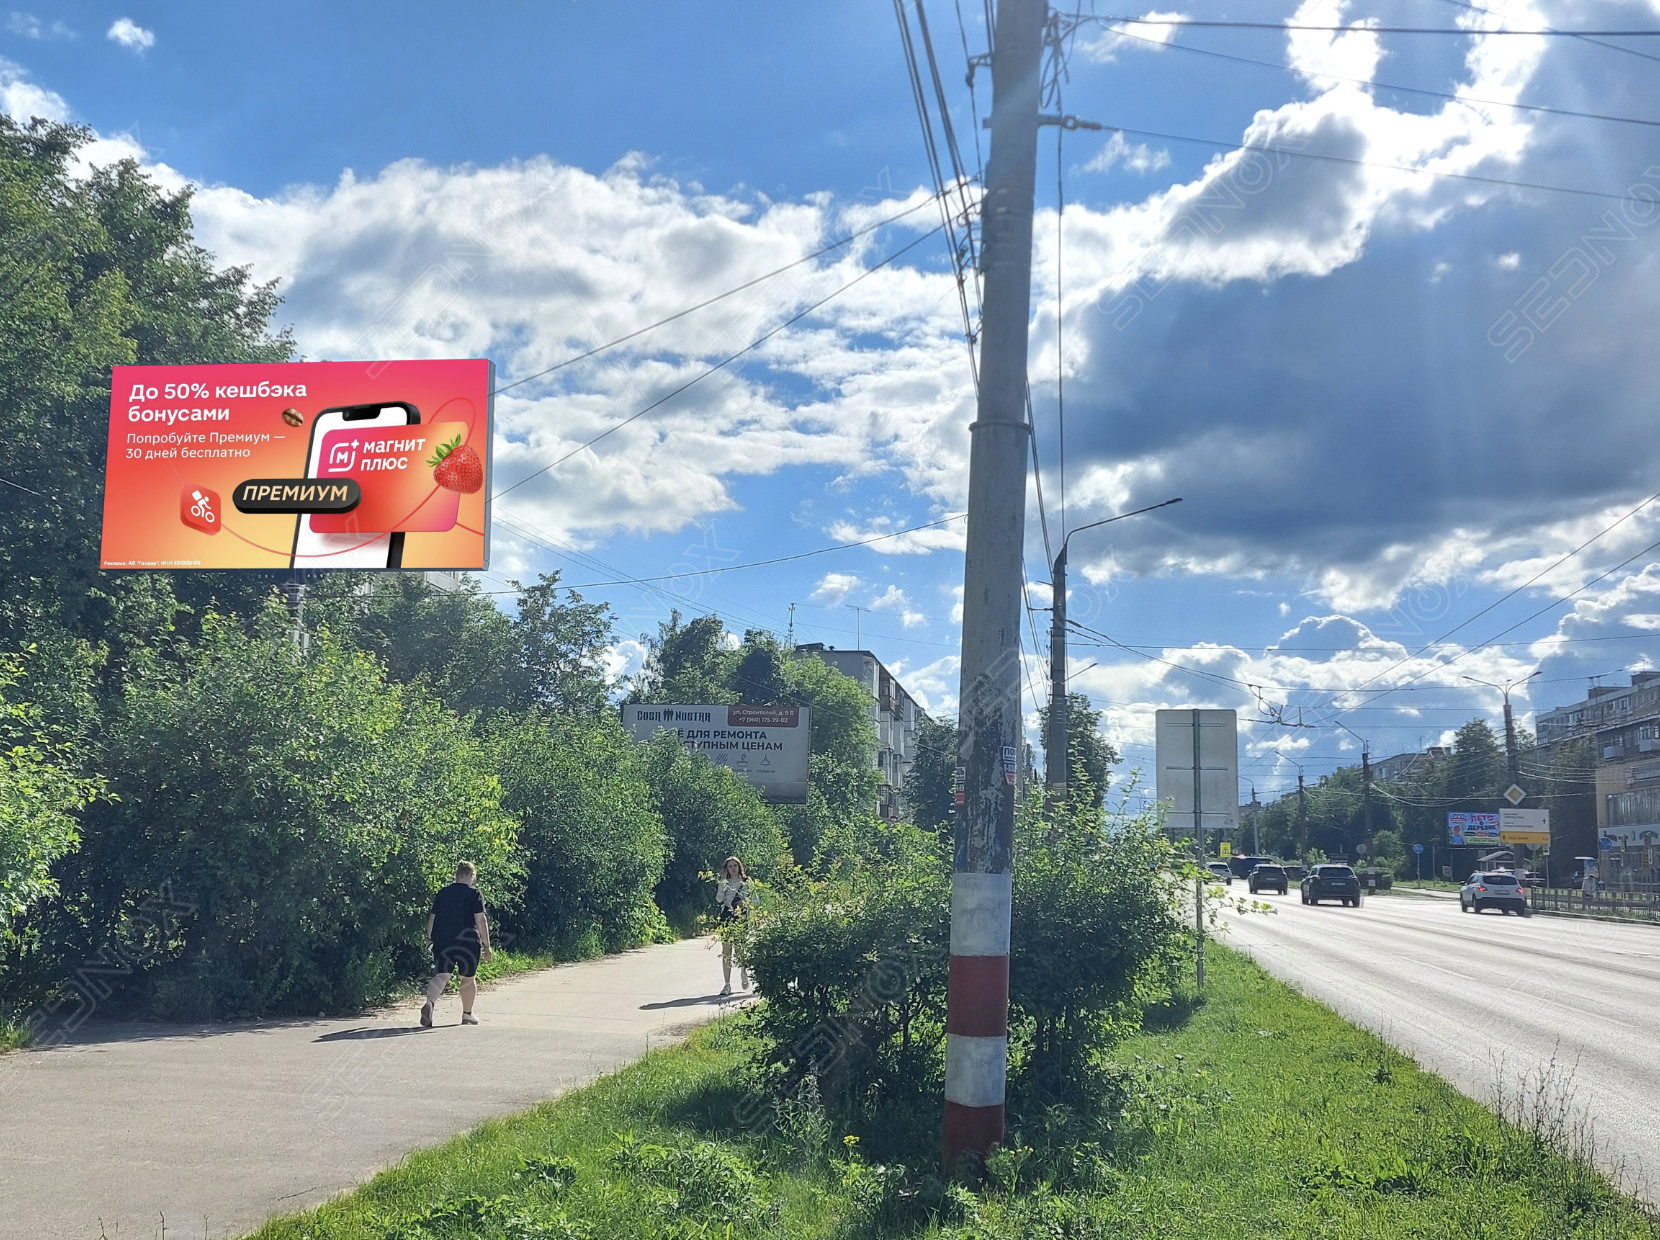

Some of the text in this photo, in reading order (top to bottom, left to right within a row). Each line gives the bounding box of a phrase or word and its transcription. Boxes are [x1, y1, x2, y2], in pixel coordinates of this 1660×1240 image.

[129, 381, 307, 402] До 50% кешбэка
[128, 406, 230, 426] бонусами
[127, 432, 206, 446] Попробуйте
[209, 432, 270, 445] Премиум
[363, 438, 426, 454] магнит
[126, 447, 251, 460] 30 дней бесплатно
[242, 485, 348, 502] ПРЕМИУМ
[687, 730, 711, 741] ДЛЯ
[713, 730, 768, 740] РЕМОНТА
[742, 742, 784, 752] ЦЕНАМ
